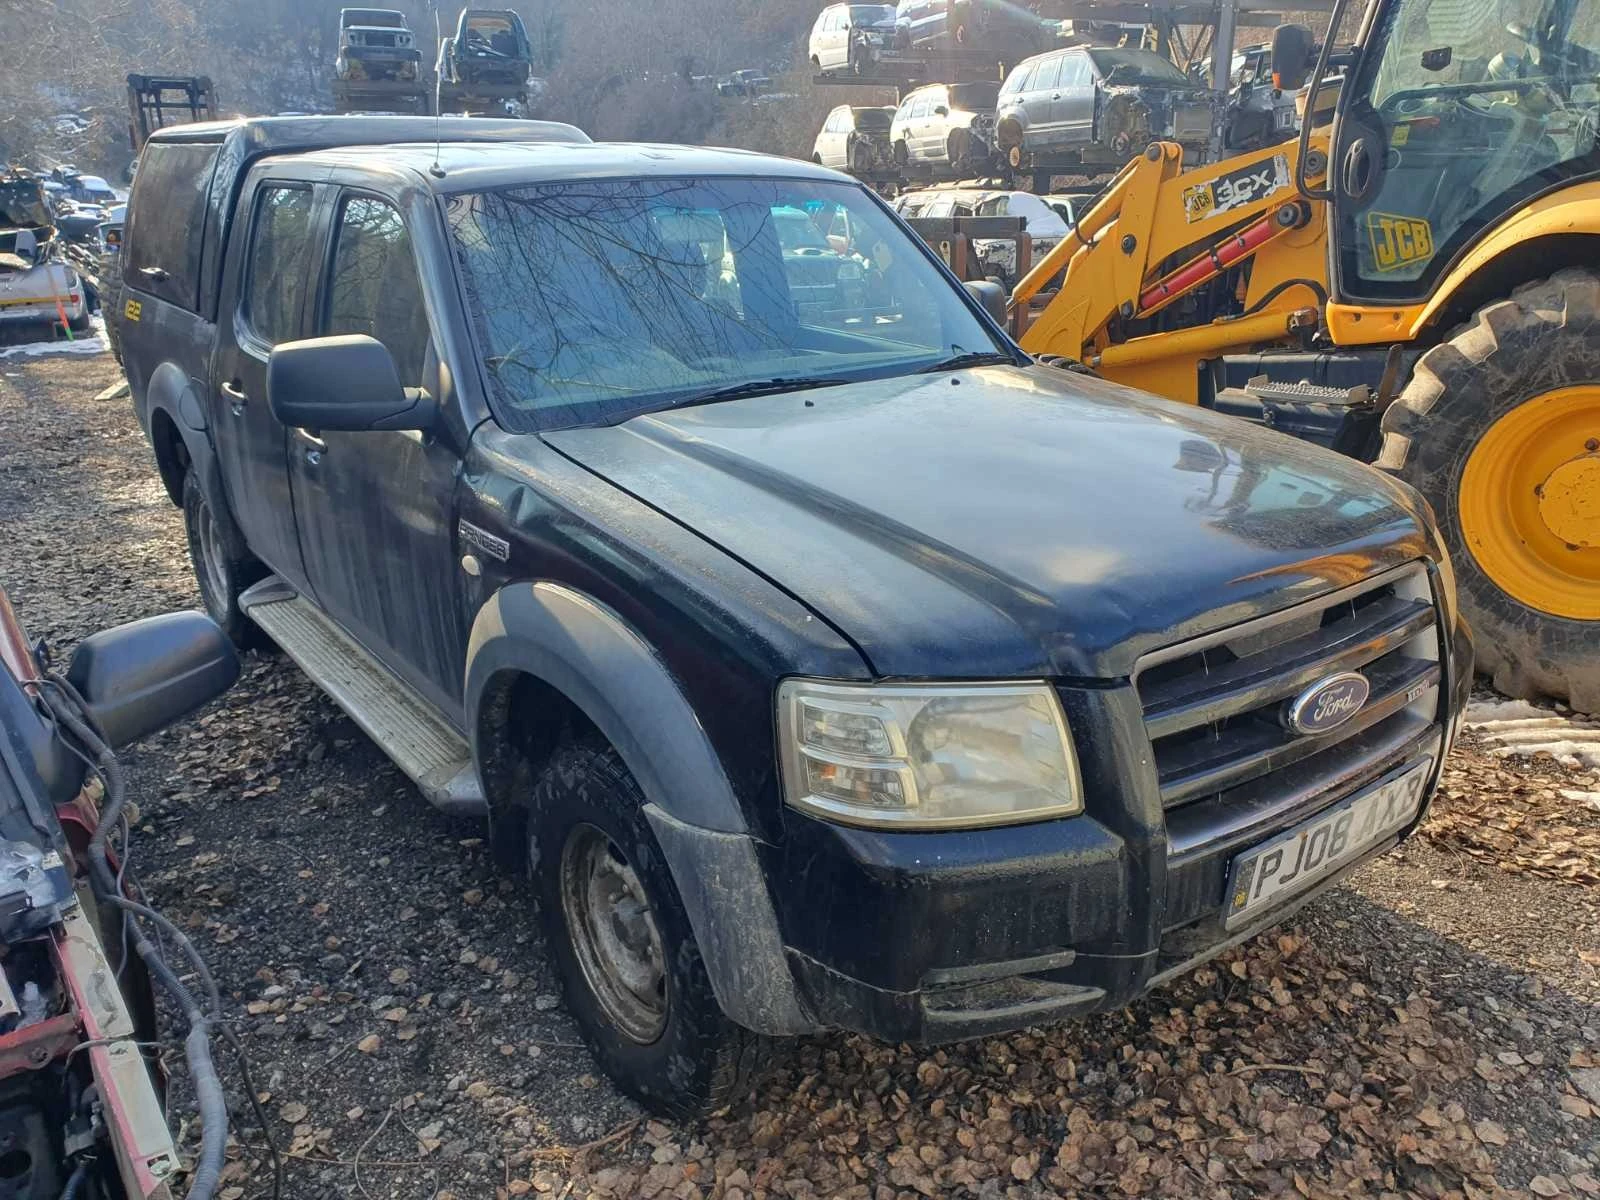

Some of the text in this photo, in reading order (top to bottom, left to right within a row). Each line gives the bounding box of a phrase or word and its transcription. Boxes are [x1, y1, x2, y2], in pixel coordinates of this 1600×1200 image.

[1191, 169, 1273, 212] JCB 3CX
[1378, 218, 1429, 265] JCB
[1313, 684, 1355, 723] Ford
